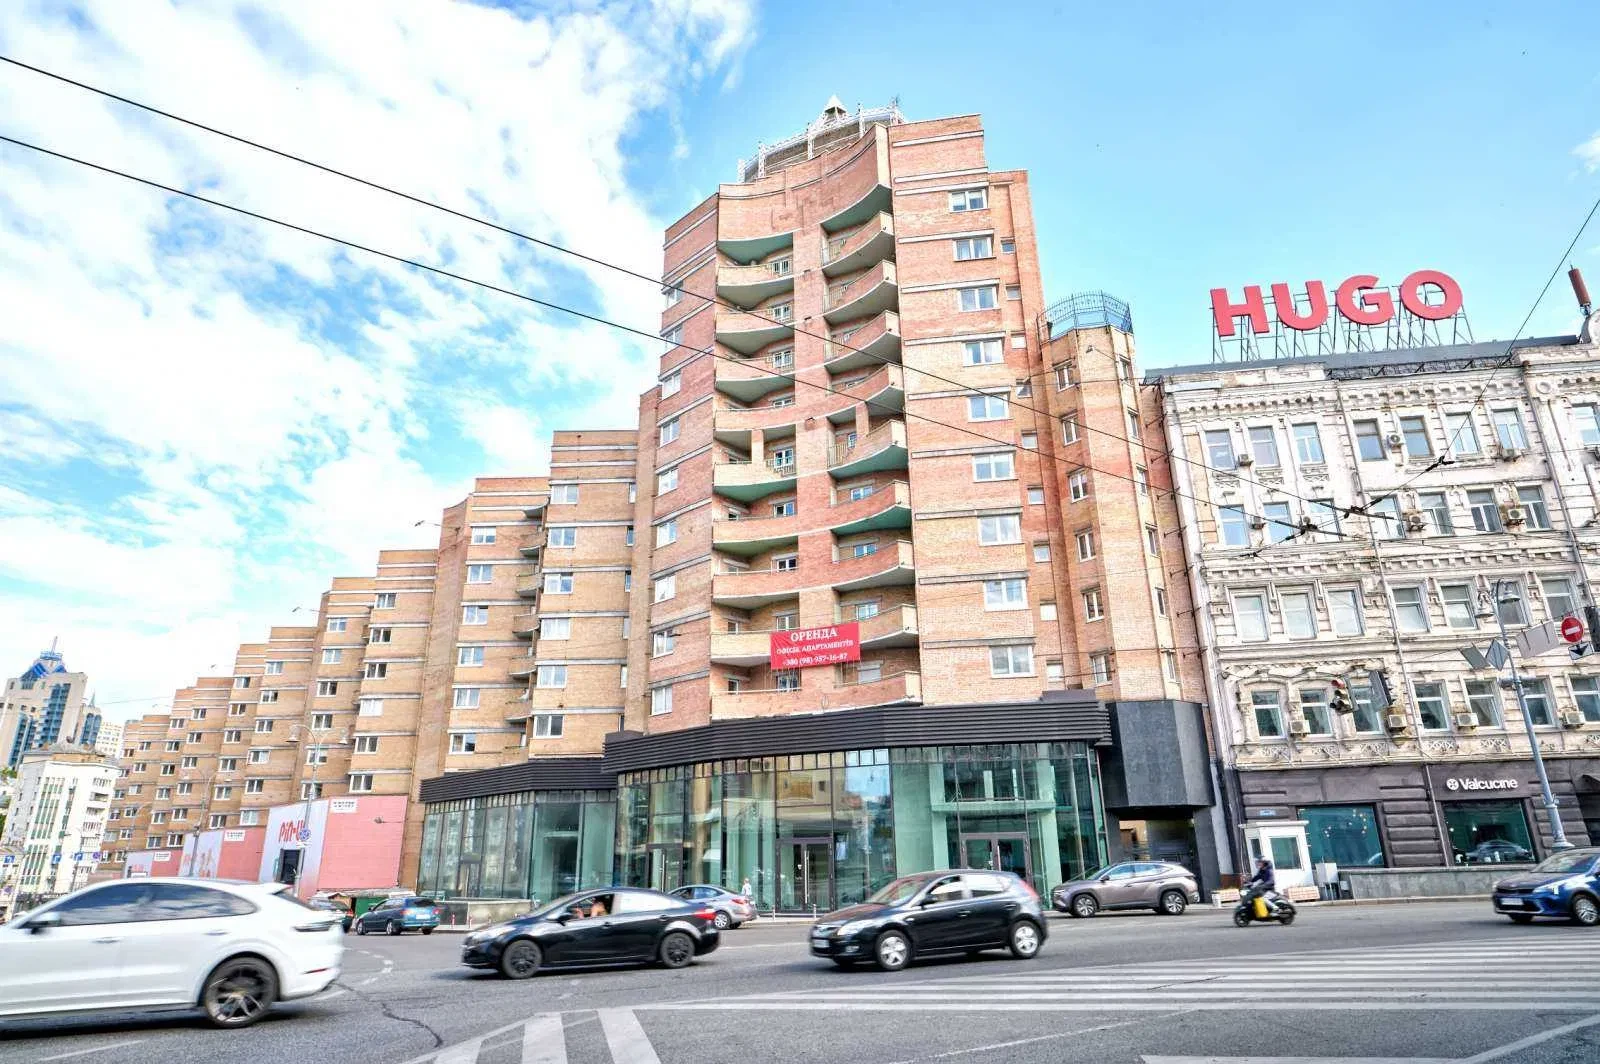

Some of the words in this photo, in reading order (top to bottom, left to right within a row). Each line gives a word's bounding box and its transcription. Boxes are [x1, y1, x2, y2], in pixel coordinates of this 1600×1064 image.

[1210, 270, 1464, 336] HUGO
[790, 628, 838, 642] ОРЕНДА
[1459, 778, 1518, 790] Valcucine
